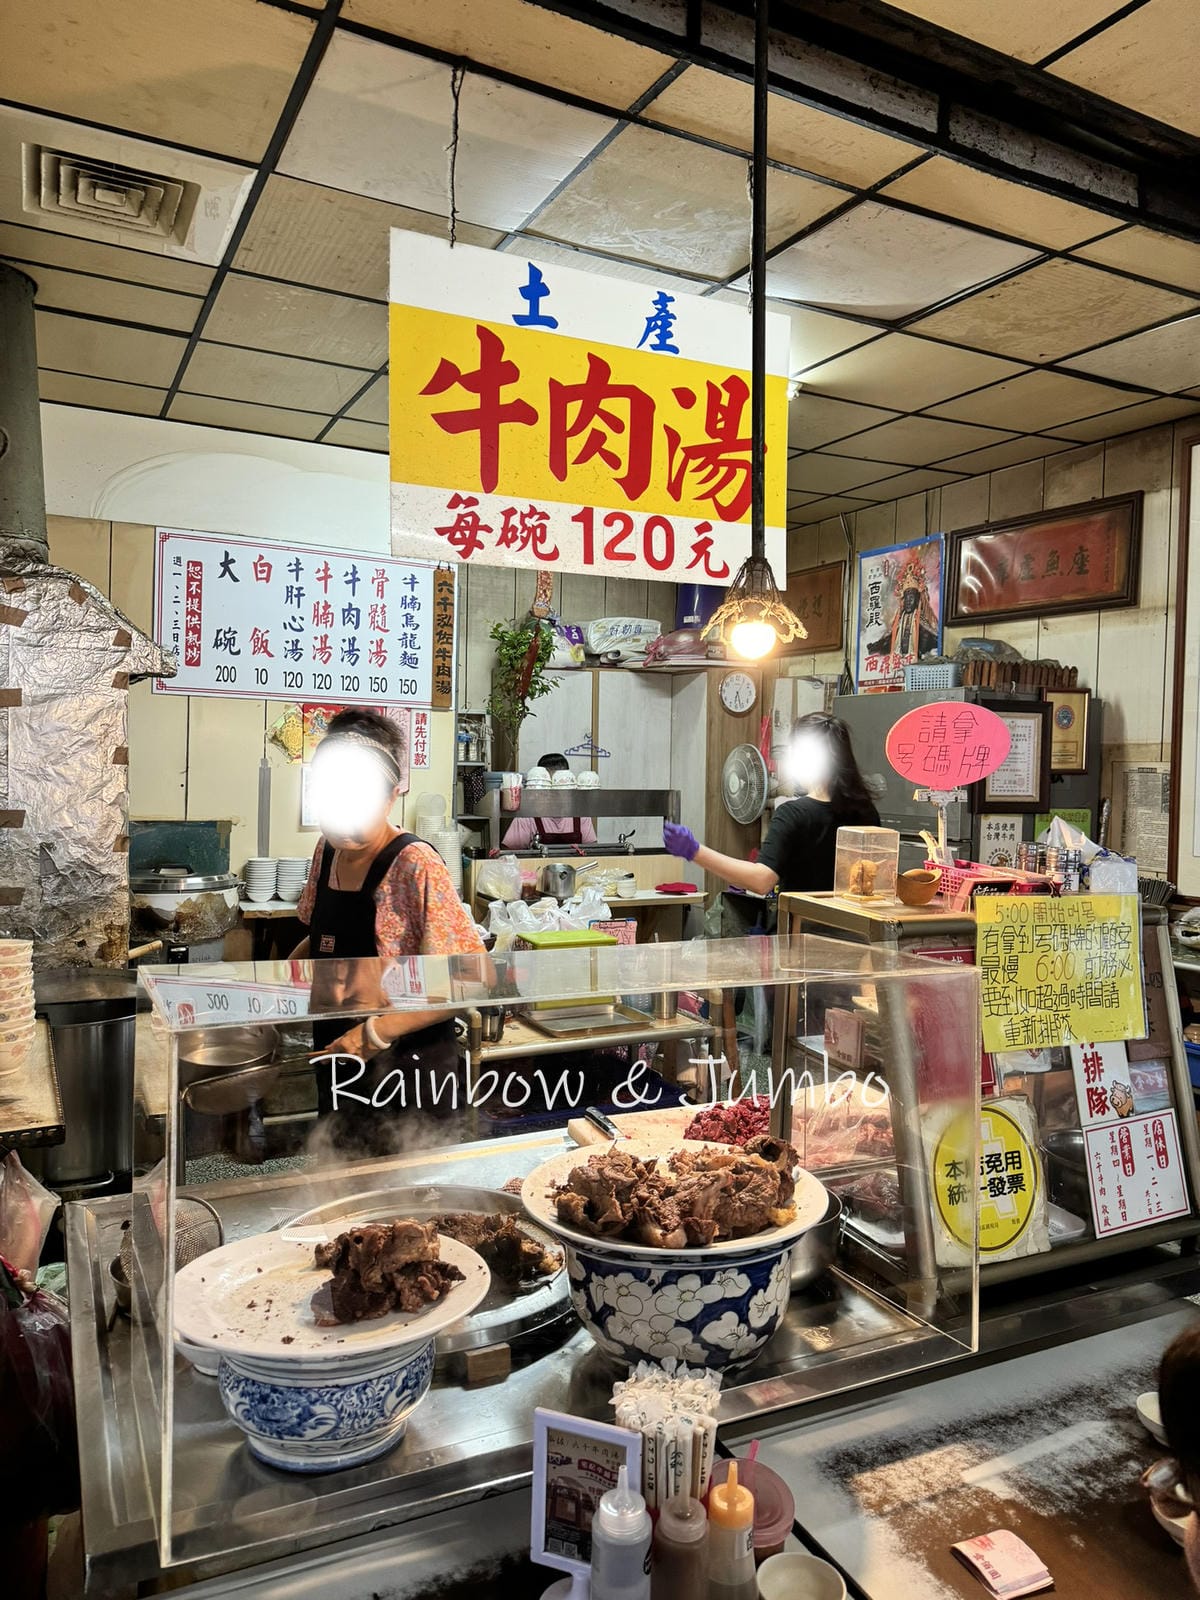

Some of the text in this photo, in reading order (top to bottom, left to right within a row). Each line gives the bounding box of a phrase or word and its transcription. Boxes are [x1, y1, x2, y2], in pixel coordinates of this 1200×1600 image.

[512, 262, 680, 355] 土產
[418, 324, 767, 522] 牛肉湯
[434, 493, 729, 579] 每碗120元
[185, 562, 202, 664] 恕不提供熱炒
[212, 550, 241, 683] 大碗 200
[249, 554, 275, 686] 白飯 10
[282, 557, 305, 689] 牛肝心湯 120
[311, 560, 334, 690] 牛腩湯 120
[340, 564, 361, 692] 牛肉湯 120
[368, 568, 390, 694] 骨髓湯 150
[397, 573, 421, 669] 牛腩烏龍麵
[399, 678, 418, 695] 150
[919, 711, 979, 744] 請拿
[414, 712, 427, 766] 請先付款
[986, 822, 1016, 832] 本店使用
[986, 832, 1015, 841] 台灣牛肉
[980, 954, 1019, 985] 最慢
[1036, 952, 1076, 982] 6:00
[1084, 951, 1133, 980] 前務必
[1003, 1013, 1078, 1048] 重新排隊
[1080, 1042, 1111, 1118] 排隊
[1119, 1127, 1134, 1176] 營業日
[1152, 1120, 1168, 1168] 店休日
